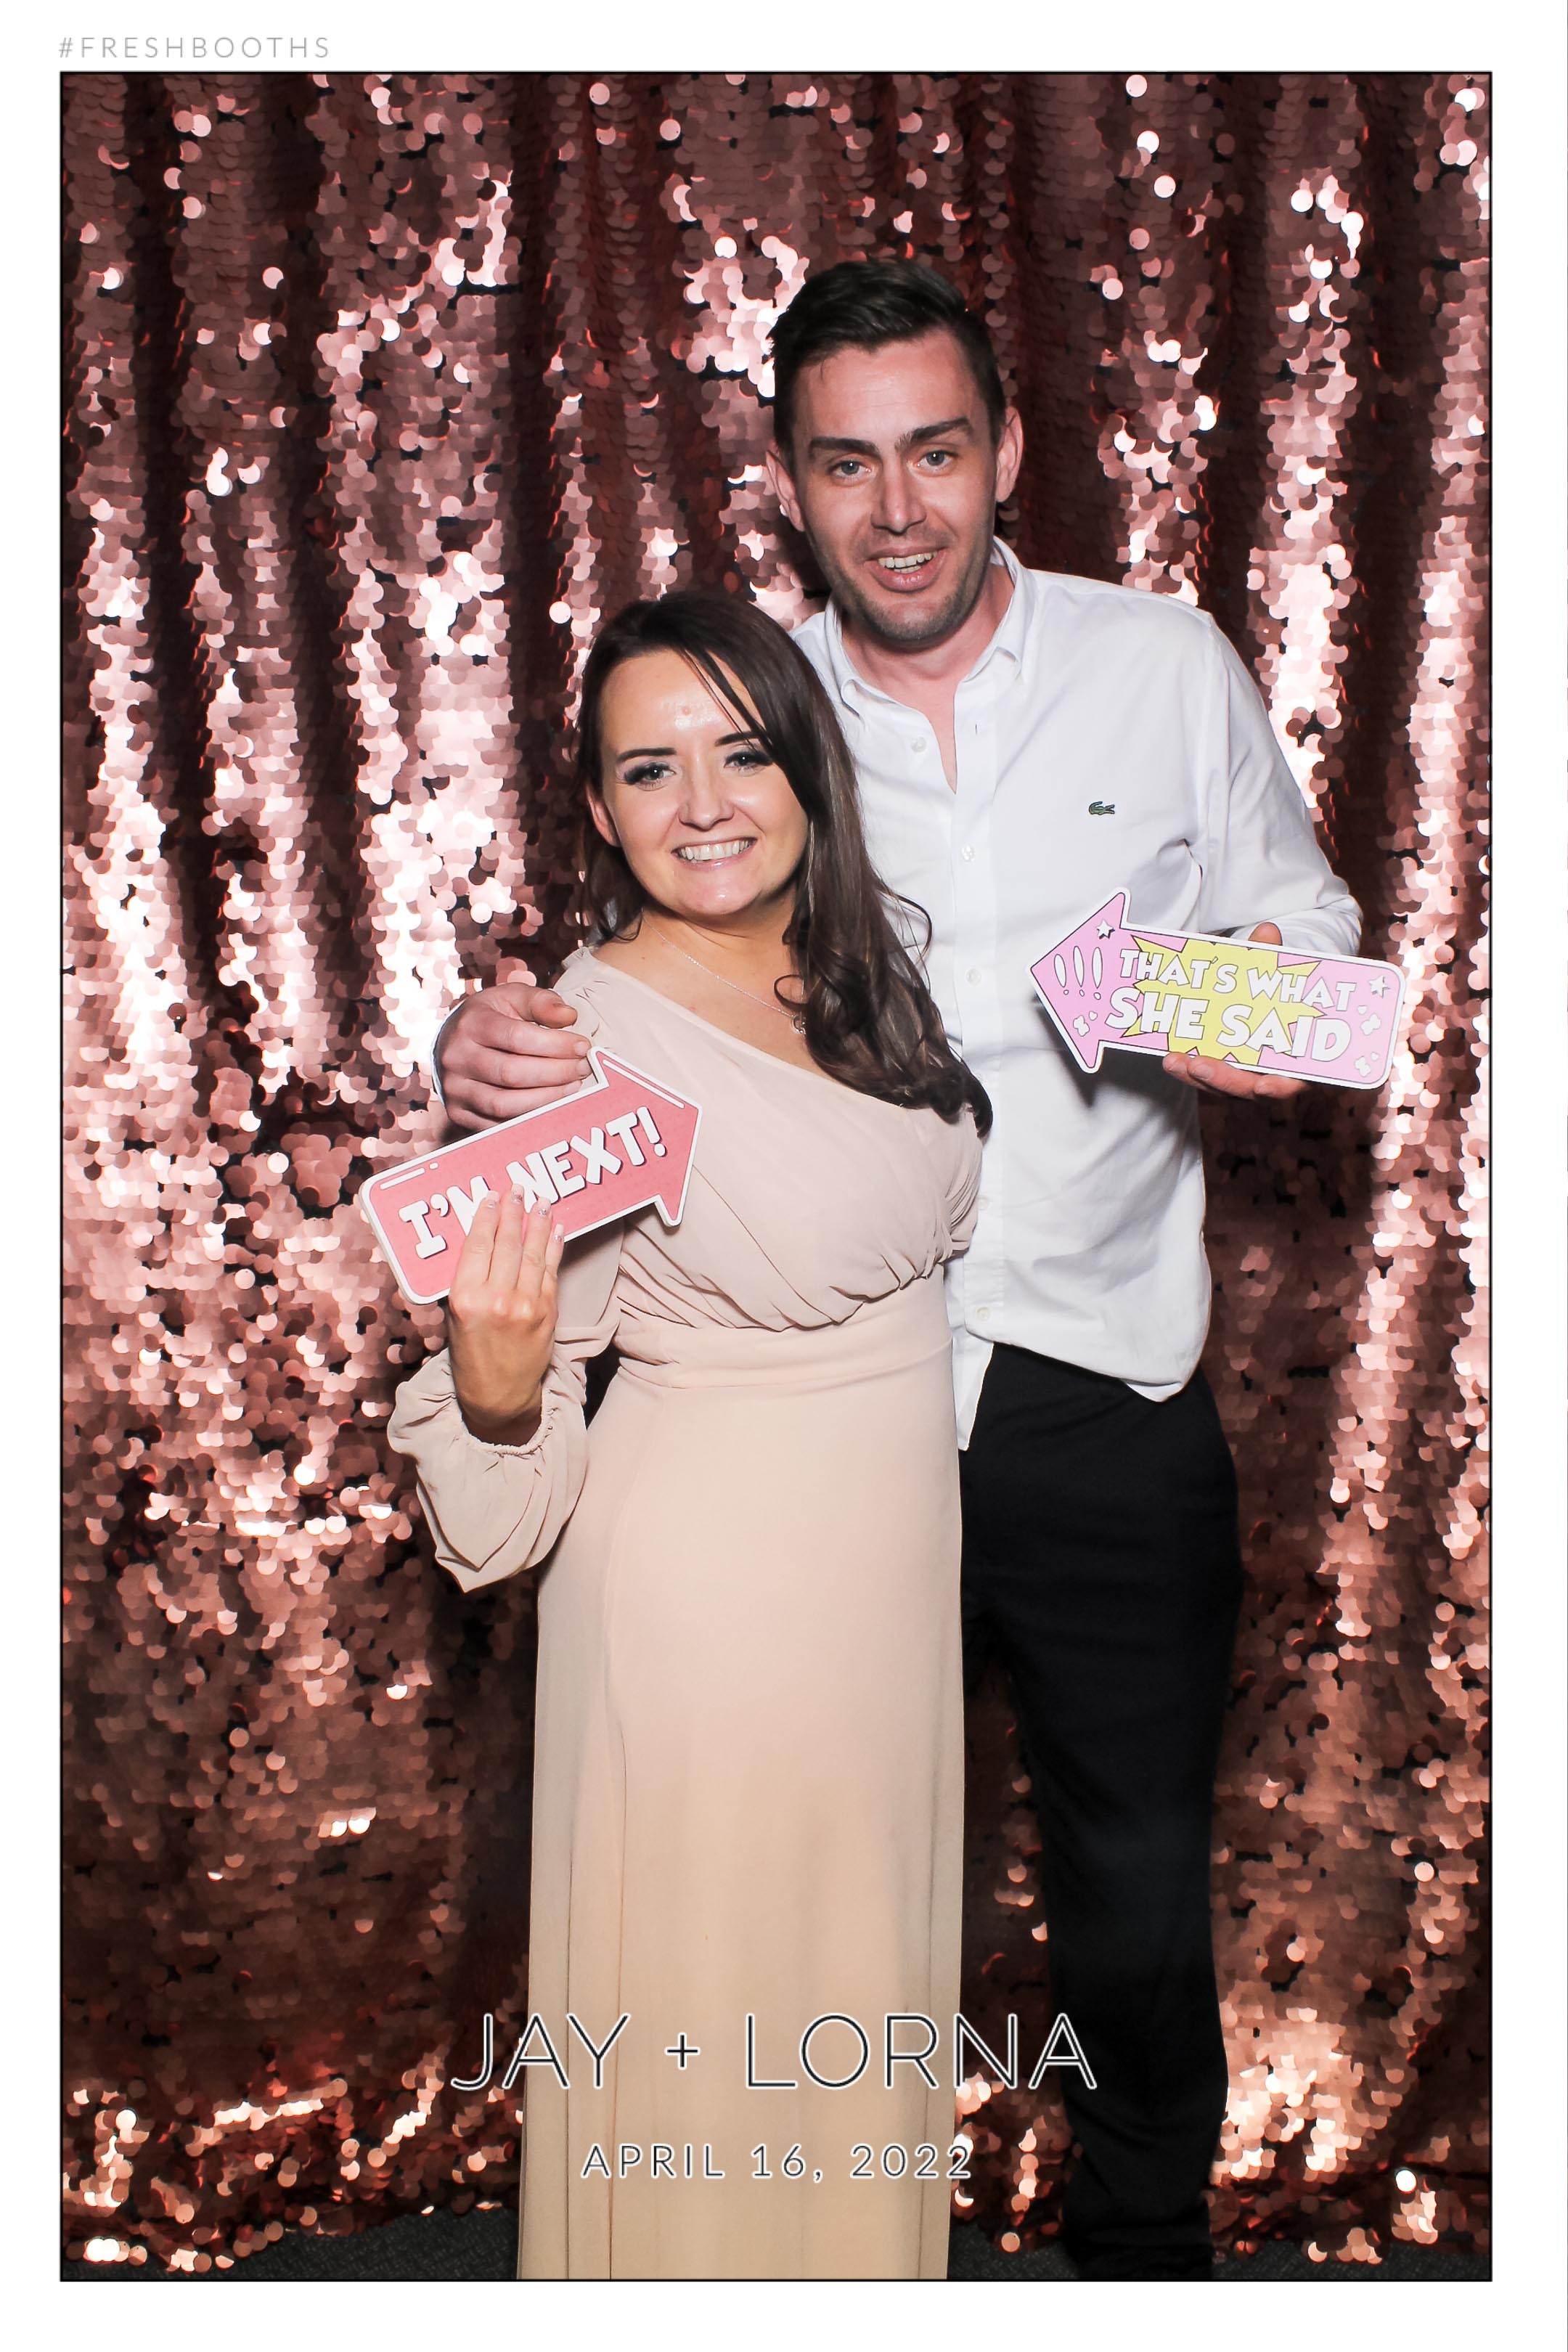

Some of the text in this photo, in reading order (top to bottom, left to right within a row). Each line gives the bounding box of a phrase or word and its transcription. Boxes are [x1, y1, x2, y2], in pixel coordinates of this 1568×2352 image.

[1119, 948, 1357, 1012] THAT'S WHAT
[1105, 987, 1352, 1062] SHE SAID
[505, 1106, 666, 1214] NEXT!
